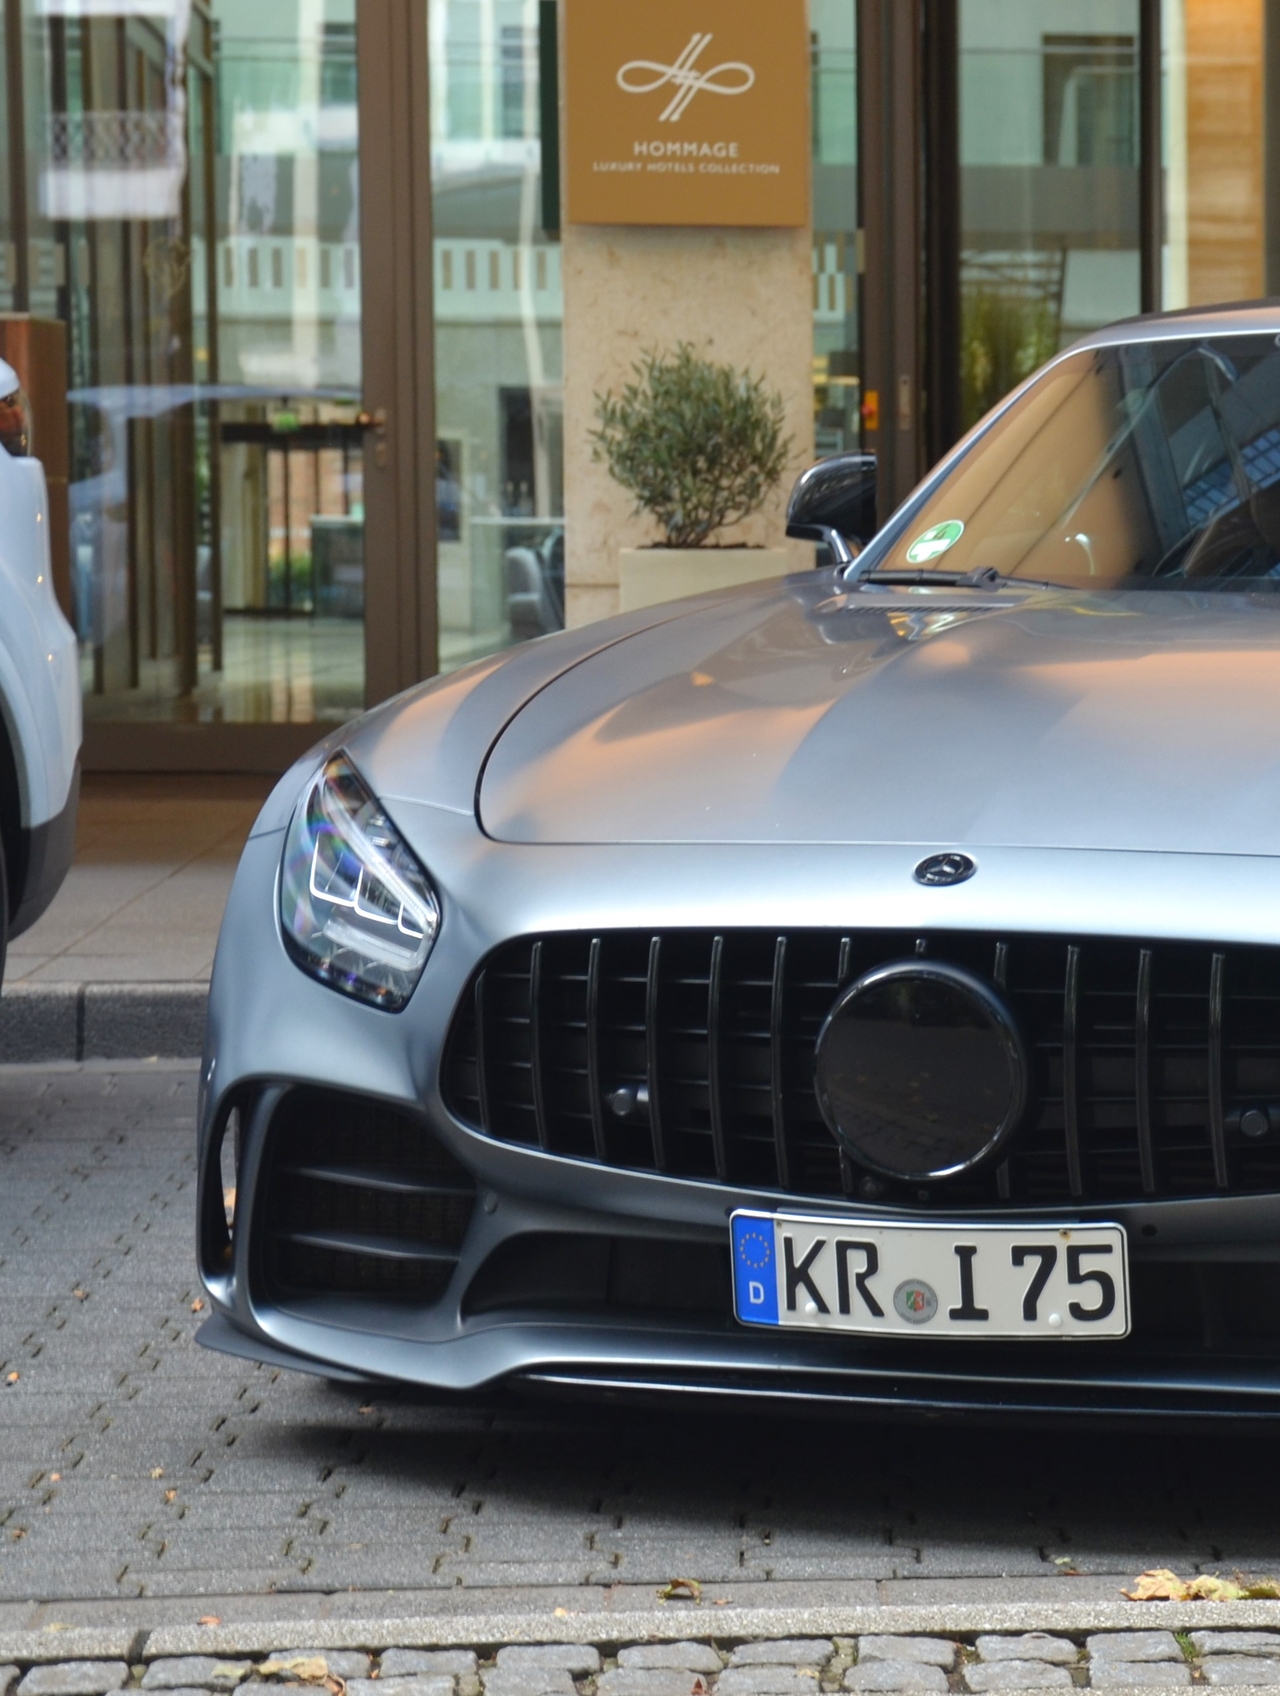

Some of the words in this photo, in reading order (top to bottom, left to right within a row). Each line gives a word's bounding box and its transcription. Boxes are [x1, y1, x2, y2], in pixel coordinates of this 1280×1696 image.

[633, 141, 739, 158] HOMMAGE
[593, 161, 643, 172] LUXURY
[647, 161, 695, 173] HOTELS
[698, 162, 780, 174] COLLECTION
[783, 1235, 885, 1318] KR
[947, 1244, 990, 1321] I
[1010, 1243, 1116, 1322] 75
[749, 1281, 766, 1305] D
